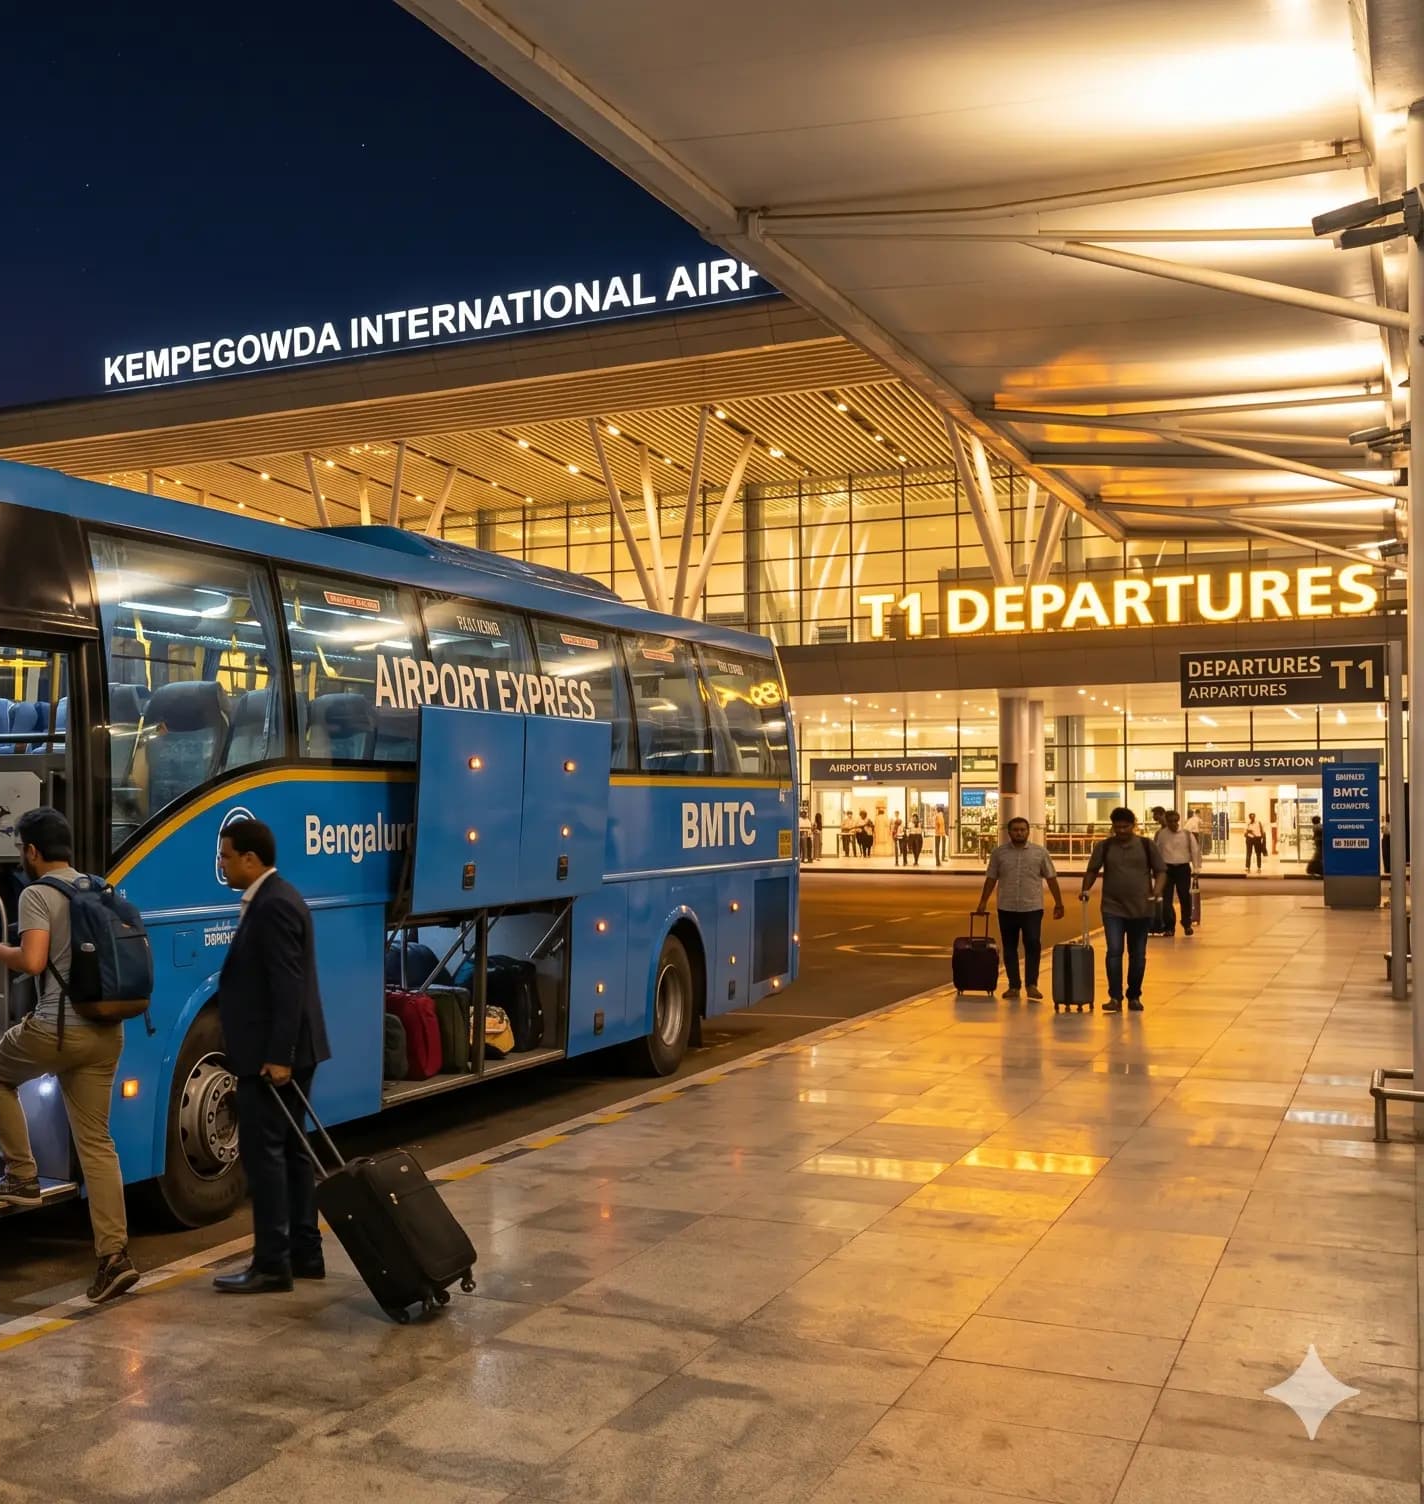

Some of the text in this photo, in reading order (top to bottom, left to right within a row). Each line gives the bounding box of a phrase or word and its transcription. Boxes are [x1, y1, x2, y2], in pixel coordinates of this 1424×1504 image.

[103, 322, 342, 386] KEMPEGOWDA
[350, 273, 656, 348] INTERNATIONAL
[857, 563, 1381, 639] T1 DEPARTURES
[1188, 655, 1322, 679] DEPARTURES
[1330, 658, 1374, 690] T1
[375, 654, 597, 720] AIRPORT EXPRESS
[1188, 683, 1288, 700] ARPARTURES
[829, 762, 938, 773] AIRPORT BUS STATION
[1184, 758, 1235, 769] AIRPORT
[1237, 757, 1261, 769] BUS
[1263, 756, 1315, 768] STATION
[1333, 787, 1369, 798] BMTC
[681, 801, 756, 849] BMTC
